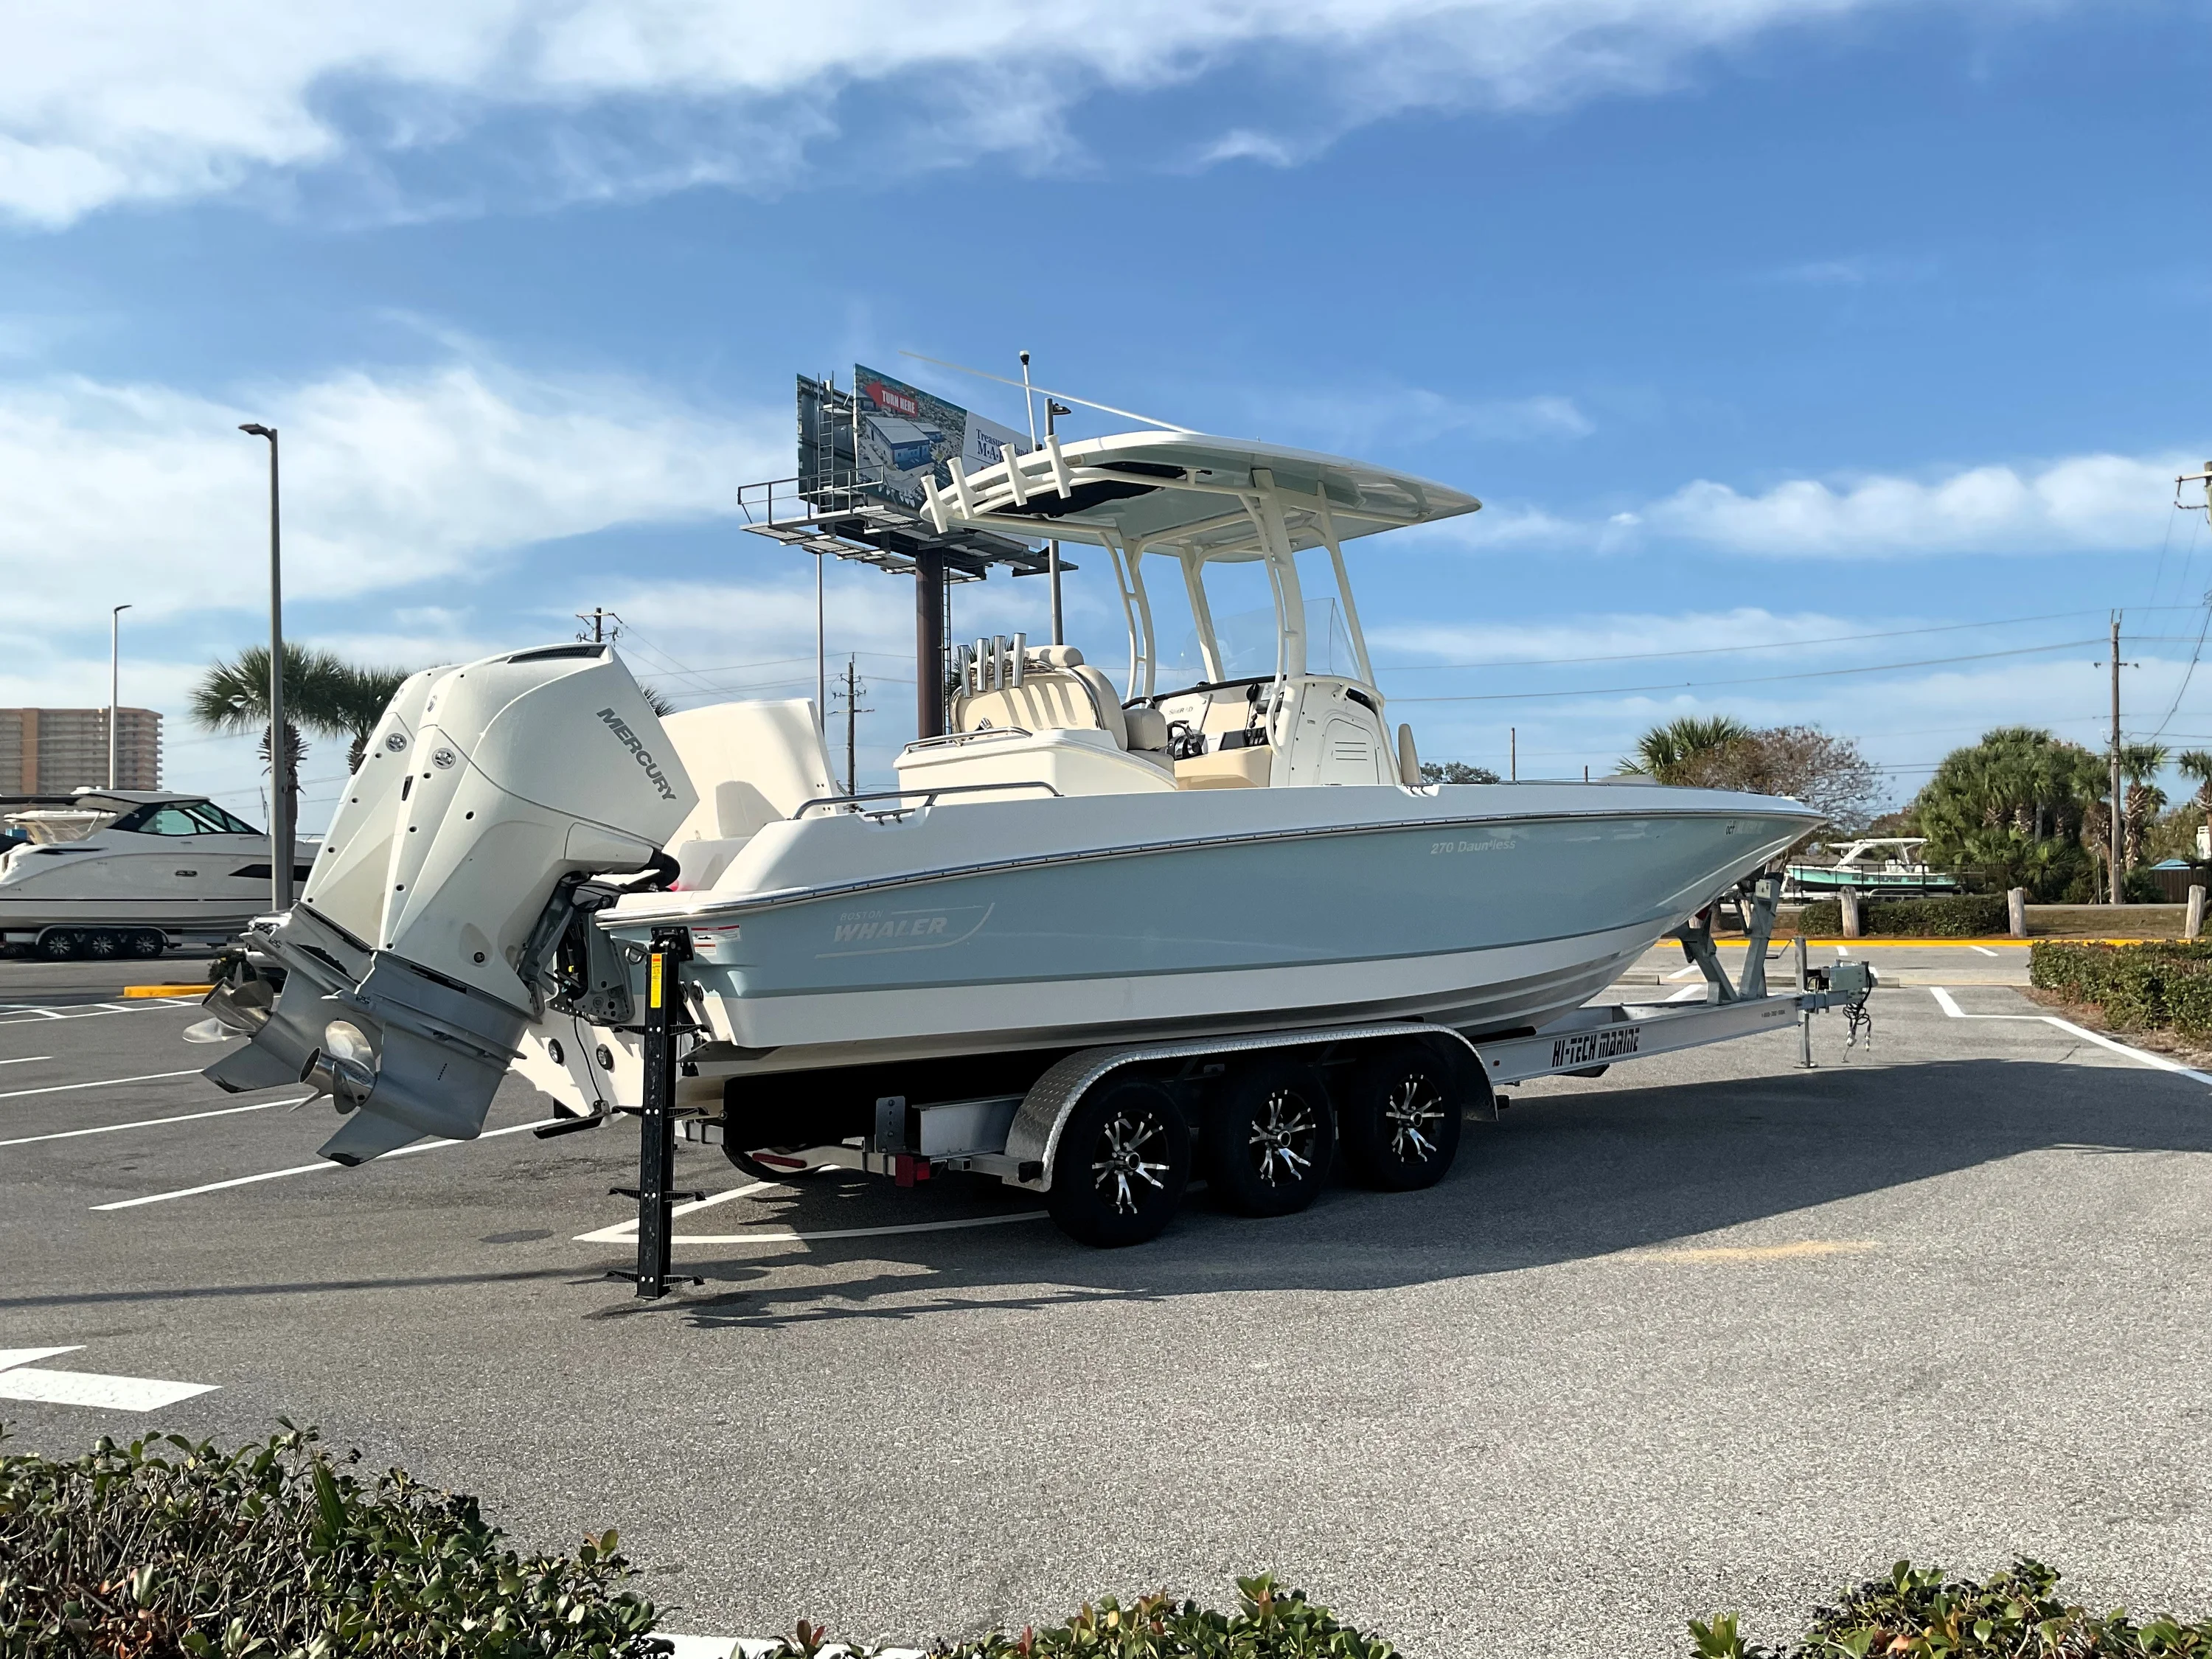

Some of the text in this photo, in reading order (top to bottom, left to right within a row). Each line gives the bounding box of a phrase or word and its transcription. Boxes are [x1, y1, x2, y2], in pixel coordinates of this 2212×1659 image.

[881, 389, 915, 414] TURN HERE
[975, 428, 1007, 447] Treasur
[596, 707, 677, 800] MERCURY
[1430, 839, 1517, 855] 270 Dauntless
[840, 910, 884, 921] BOSTON
[834, 917, 947, 942] WHALER
[1551, 1027, 1640, 1067] HI-TECH MARINE
